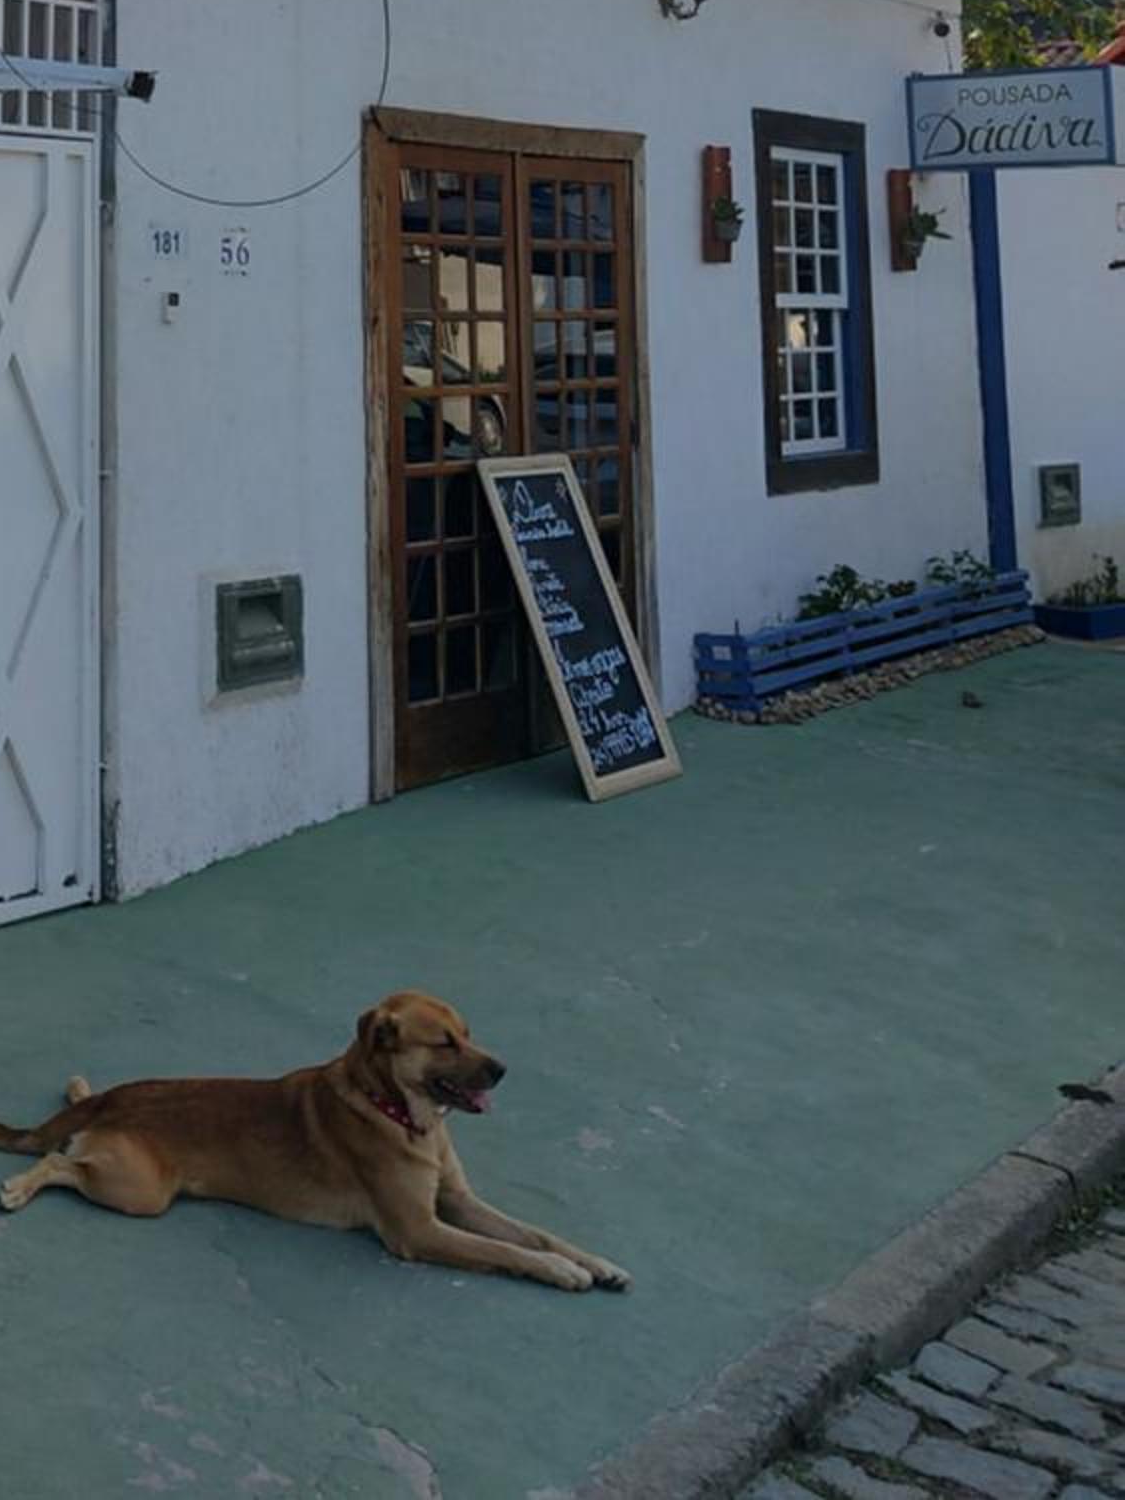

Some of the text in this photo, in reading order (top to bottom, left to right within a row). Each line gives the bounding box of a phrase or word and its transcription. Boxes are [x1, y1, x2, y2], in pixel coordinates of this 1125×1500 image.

[957, 83, 1072, 107] POUSADA
[153, 230, 180, 255] 181
[220, 237, 250, 266] 56
